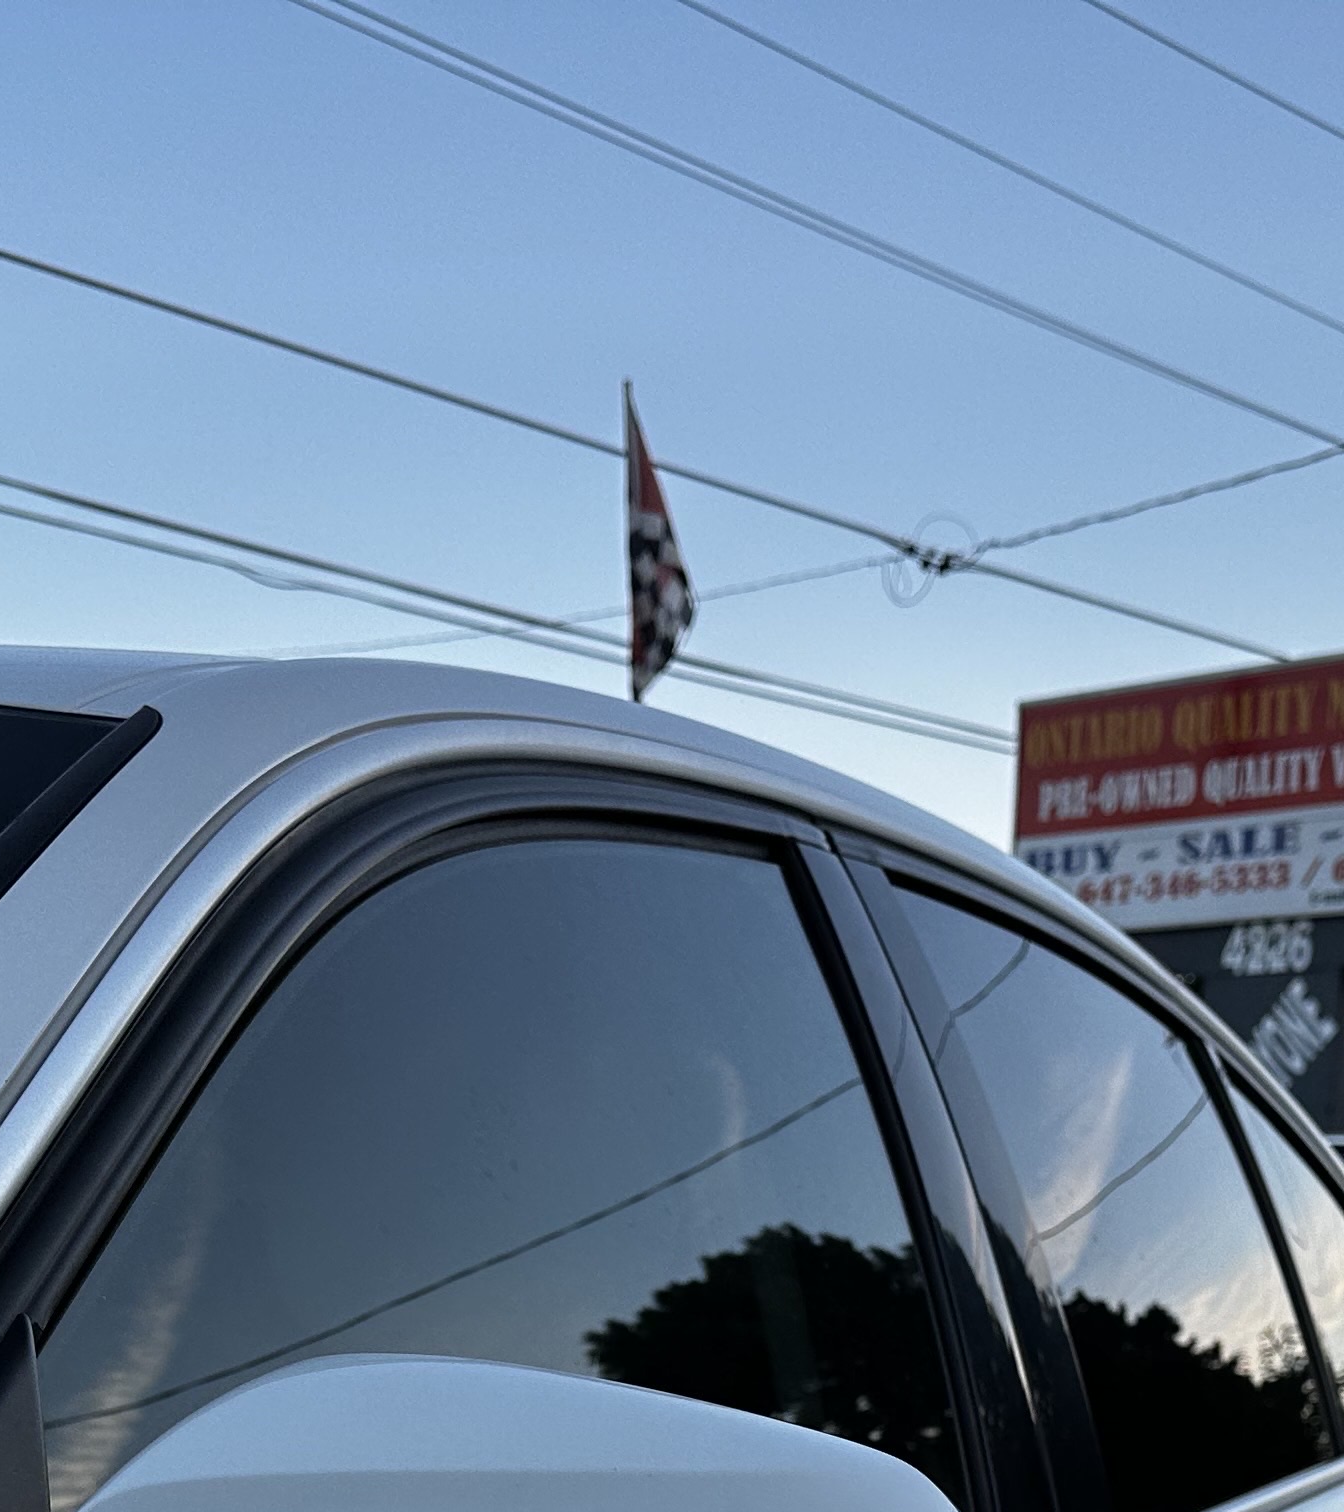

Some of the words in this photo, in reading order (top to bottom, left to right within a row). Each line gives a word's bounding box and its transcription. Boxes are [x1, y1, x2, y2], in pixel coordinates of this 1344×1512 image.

[1024, 705, 1163, 768] ONTARIO
[1172, 684, 1316, 750] QUALITY
[1038, 763, 1197, 821] PRE-OWNED
[1203, 744, 1324, 806] QUALITY
[1024, 840, 1121, 876] BUY
[1176, 822, 1301, 864] SALE
